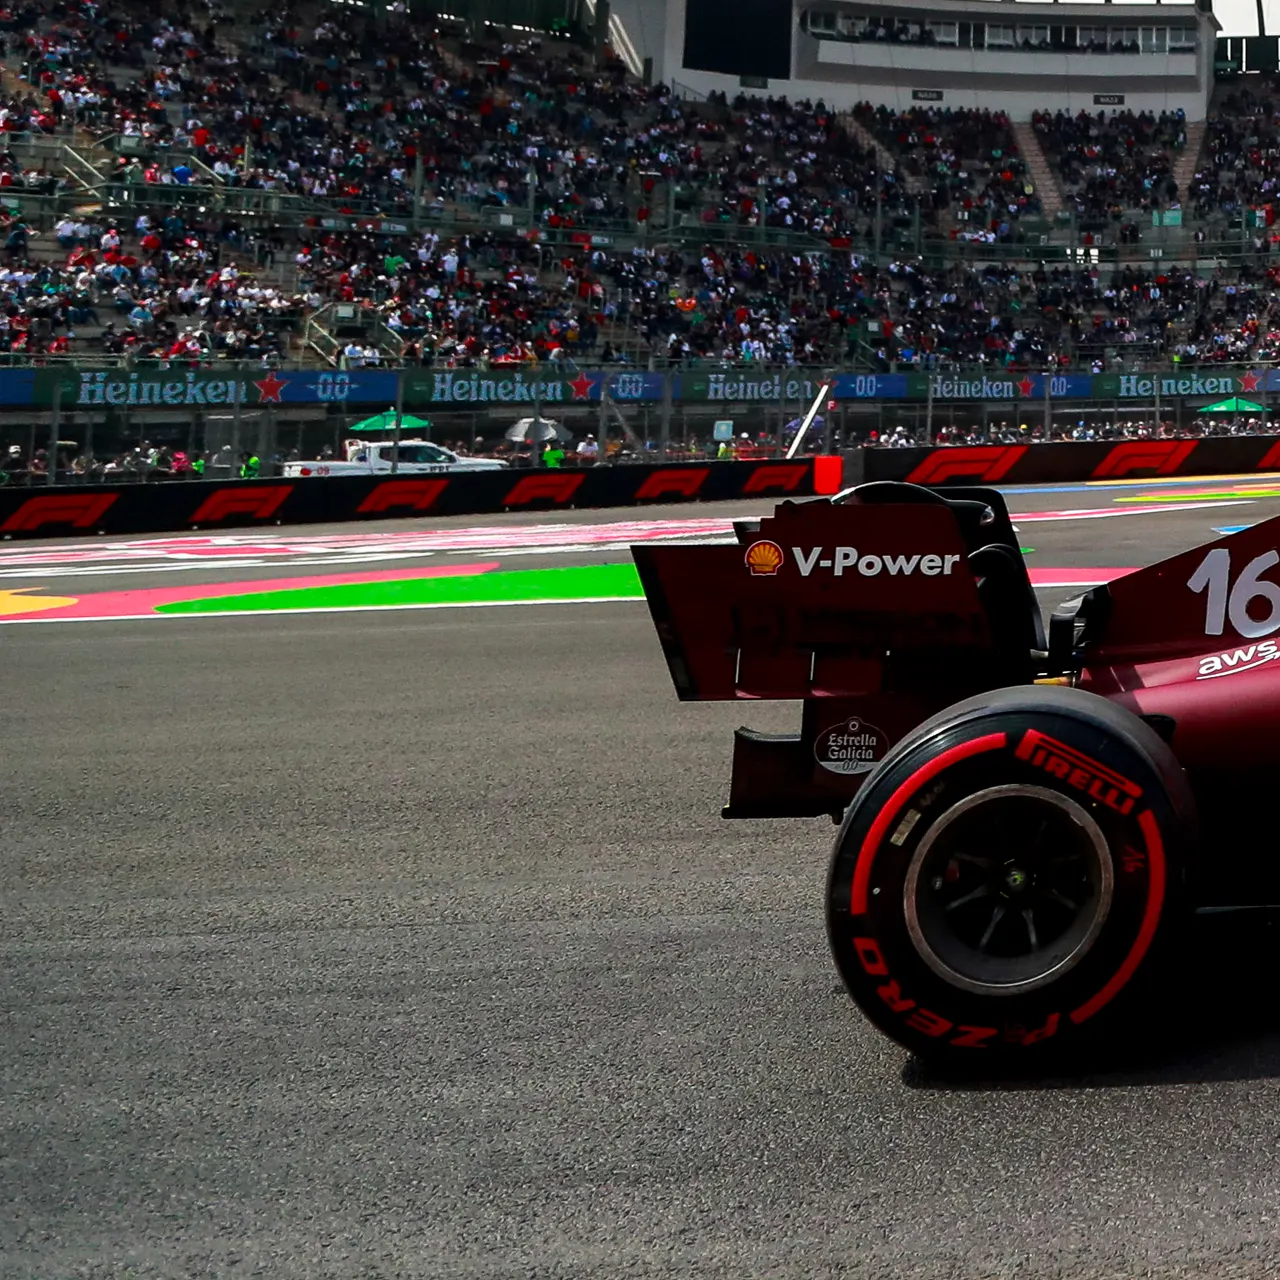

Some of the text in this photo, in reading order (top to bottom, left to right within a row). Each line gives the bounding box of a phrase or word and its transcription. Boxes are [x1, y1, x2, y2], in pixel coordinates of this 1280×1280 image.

[78, 371, 247, 404] Heineken
[431, 373, 562, 402] Heineken
[932, 375, 1014, 399] Heineken
[1119, 374, 1233, 397] Heineken
[791, 546, 961, 577] V-Power
[827, 733, 877, 747] Estrella
[828, 747, 874, 760] Galicia
[1014, 728, 1145, 816] PIRELLI
